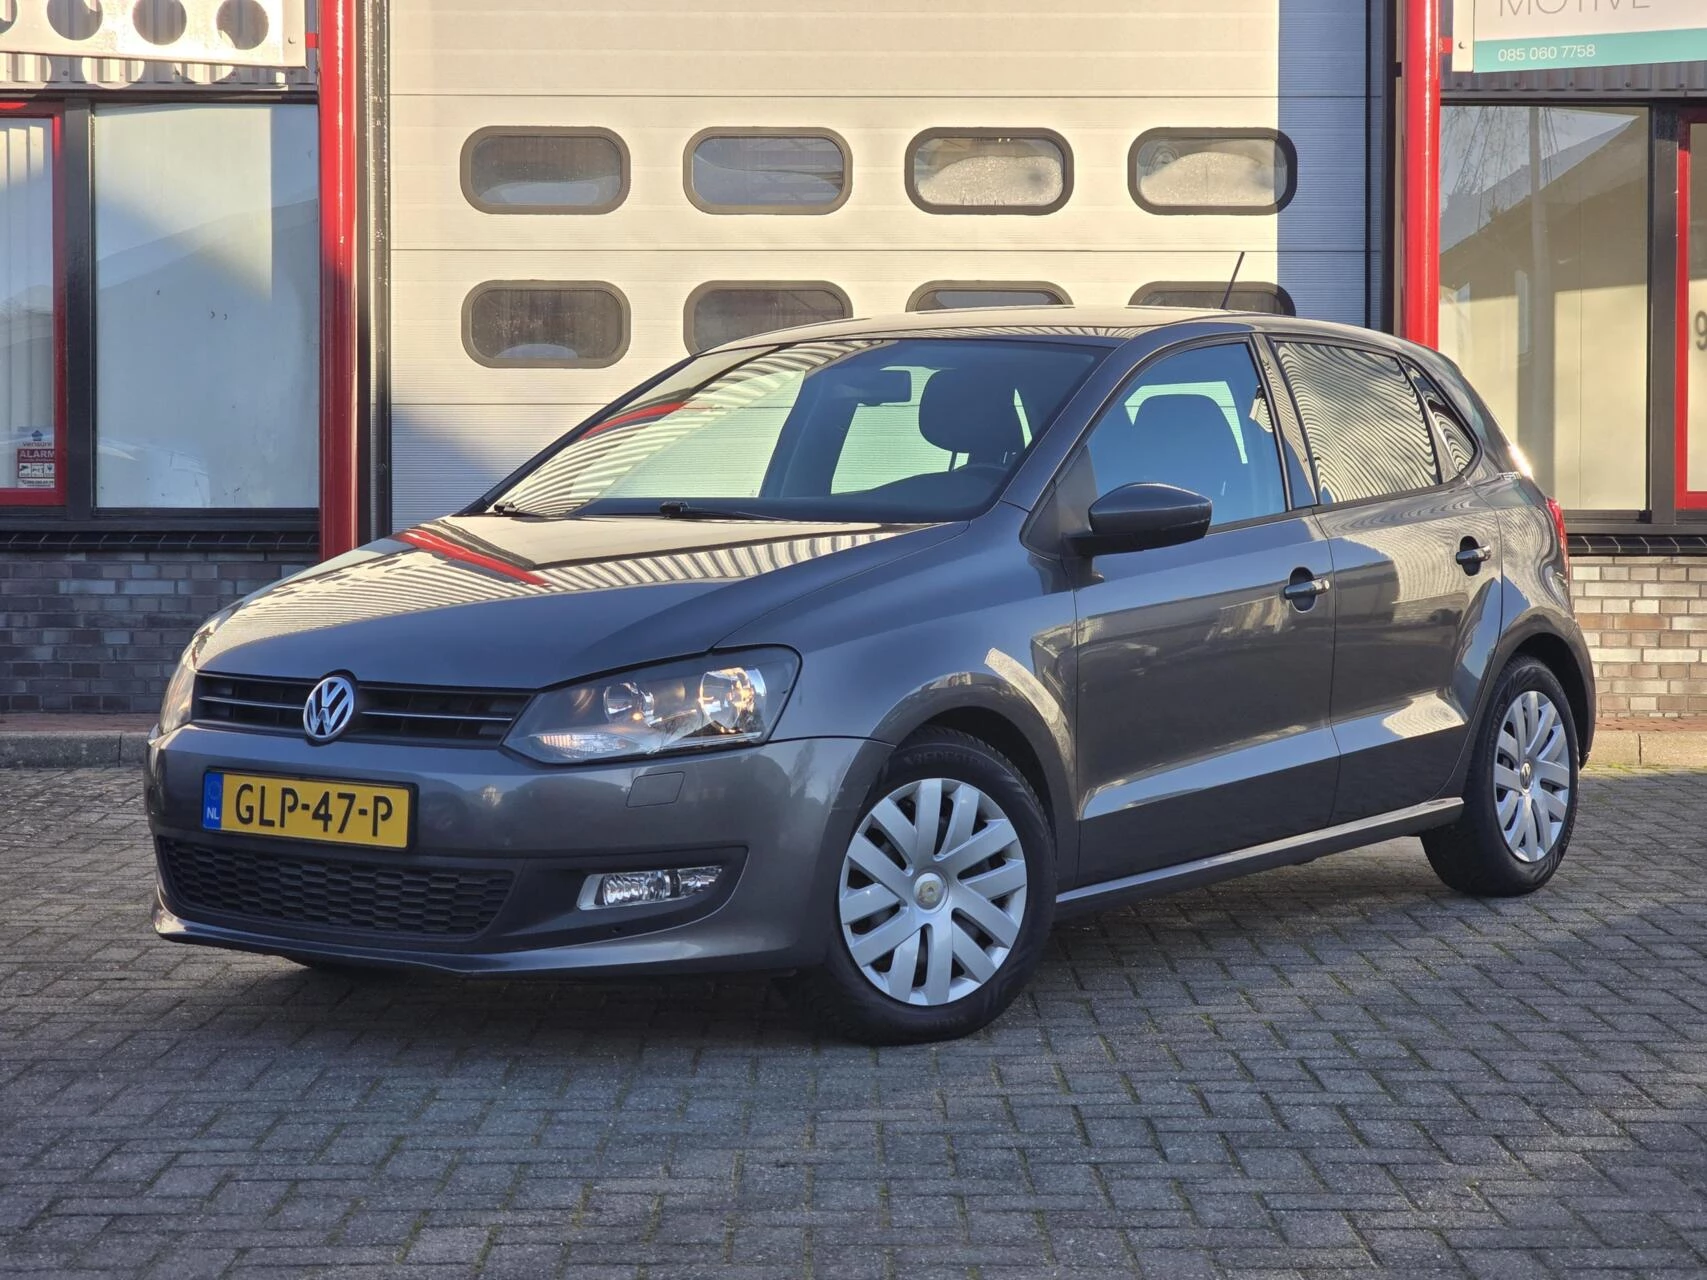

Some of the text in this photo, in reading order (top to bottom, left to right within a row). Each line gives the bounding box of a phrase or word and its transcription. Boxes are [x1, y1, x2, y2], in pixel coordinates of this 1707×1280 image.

[1498, 44, 1596, 62] 085 060 7758
[1695, 310, 1707, 351] 9
[206, 807, 220, 820] NL
[236, 783, 393, 837] GLP-47-P
